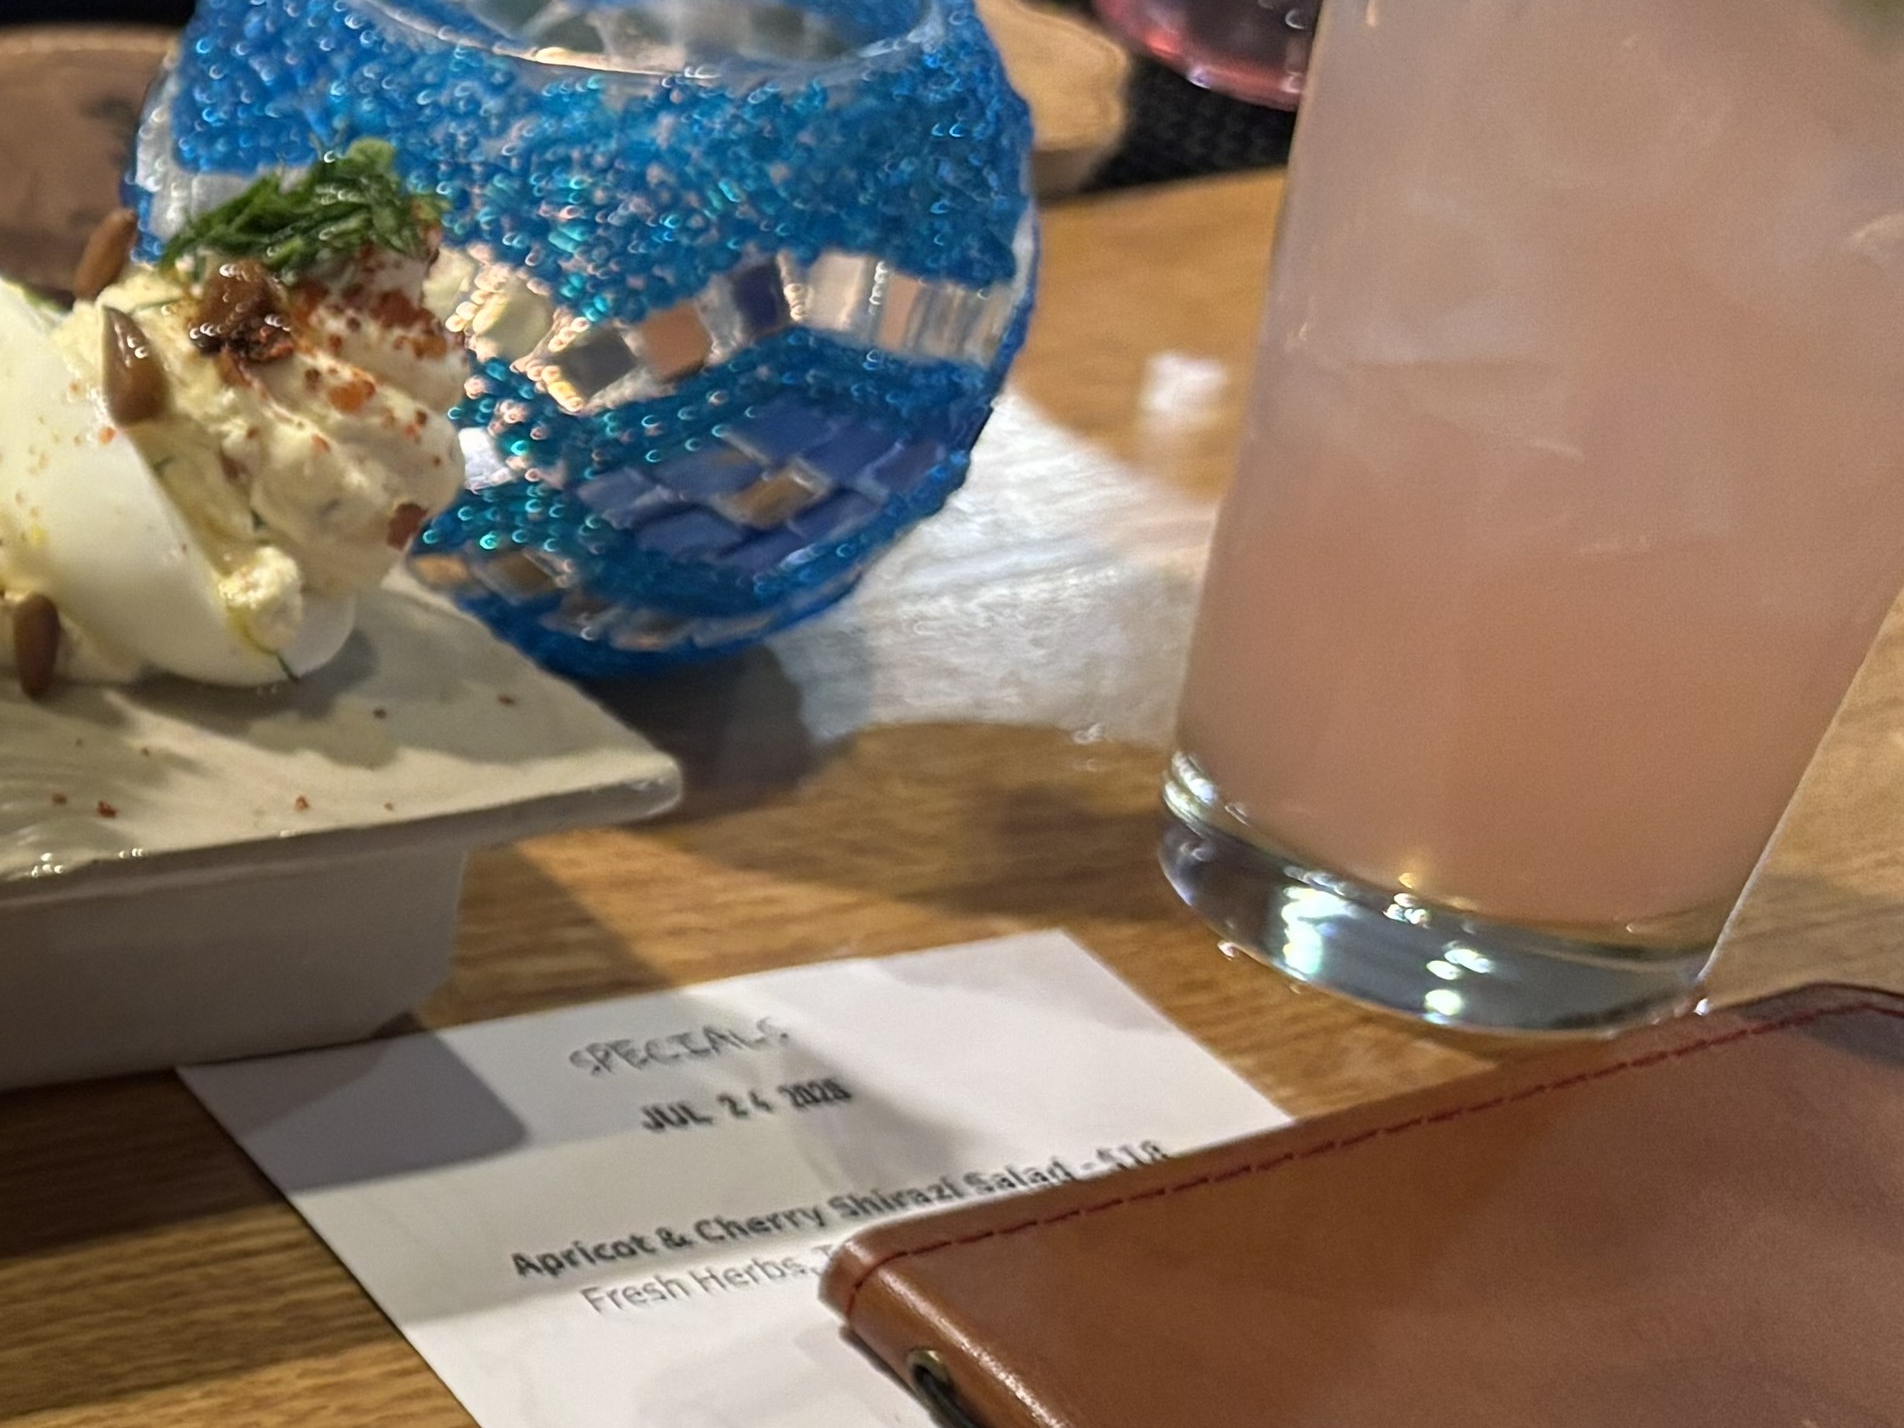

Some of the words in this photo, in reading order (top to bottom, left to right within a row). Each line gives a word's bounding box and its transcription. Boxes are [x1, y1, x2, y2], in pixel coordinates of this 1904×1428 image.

[568, 1016, 790, 1074] SPECIALS
[641, 1100, 716, 1133] JUL
[510, 1231, 655, 1278] Apricot
[657, 1225, 692, 1252] &
[692, 1203, 827, 1243] Cherry
[827, 1175, 966, 1218] Shirazi
[963, 1154, 1077, 1194] Salad
[580, 1274, 690, 1315] Fresh
